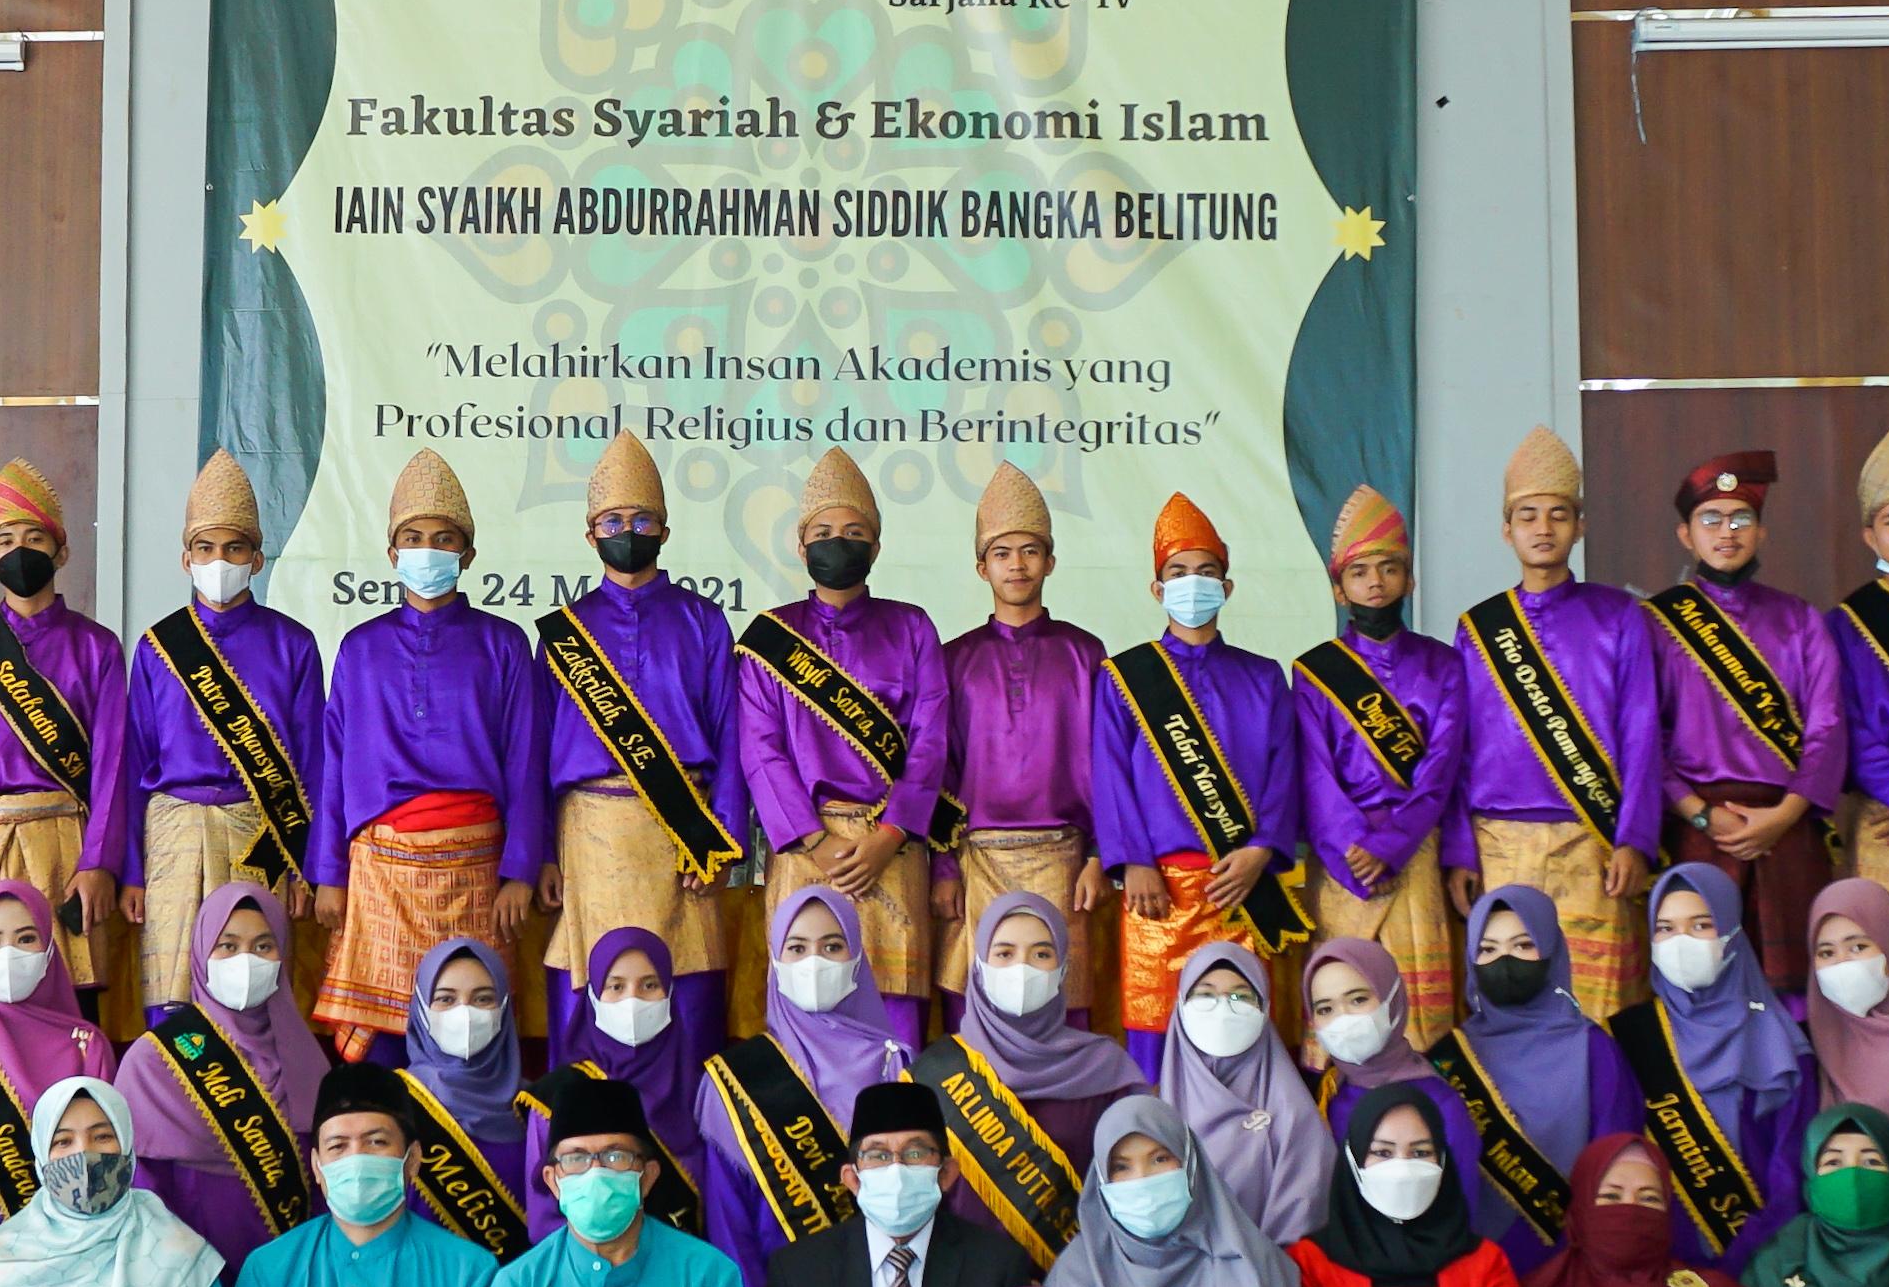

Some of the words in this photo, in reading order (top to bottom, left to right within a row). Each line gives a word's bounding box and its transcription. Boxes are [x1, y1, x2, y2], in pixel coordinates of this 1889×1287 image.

[346, 94, 576, 138] Fakultas
[593, 95, 800, 149] Syariah
[815, 101, 856, 140] &
[870, 97, 1103, 141] Ekonomi
[1119, 100, 1270, 142] Islam
[334, 186, 404, 234] IAIN
[416, 186, 542, 235] SYAIKH
[553, 187, 820, 237] ABDURRAHMAN
[832, 188, 949, 238] SIDDIK
[961, 189, 1102, 239] BANGKA
[1114, 191, 1278, 241] BELITUNG
[703, 346, 822, 381] Insan
[833, 344, 1052, 383] Akademis
[1062, 357, 1172, 393] yang
[646, 406, 813, 450] Religius
[825, 406, 907, 442] dan
[481, 572, 536, 607] 24
[1494, 626, 1523, 665] Trio
[1515, 662, 1552, 717] Desta
[1672, 597, 1767, 696] Muhammad
[190, 665, 231, 715] Putra
[196, 1061, 245, 1109] Meli
[941, 1071, 1017, 1159] ARLINDA
[784, 1115, 835, 1171] Devi
[420, 1144, 509, 1256] Melisa,
